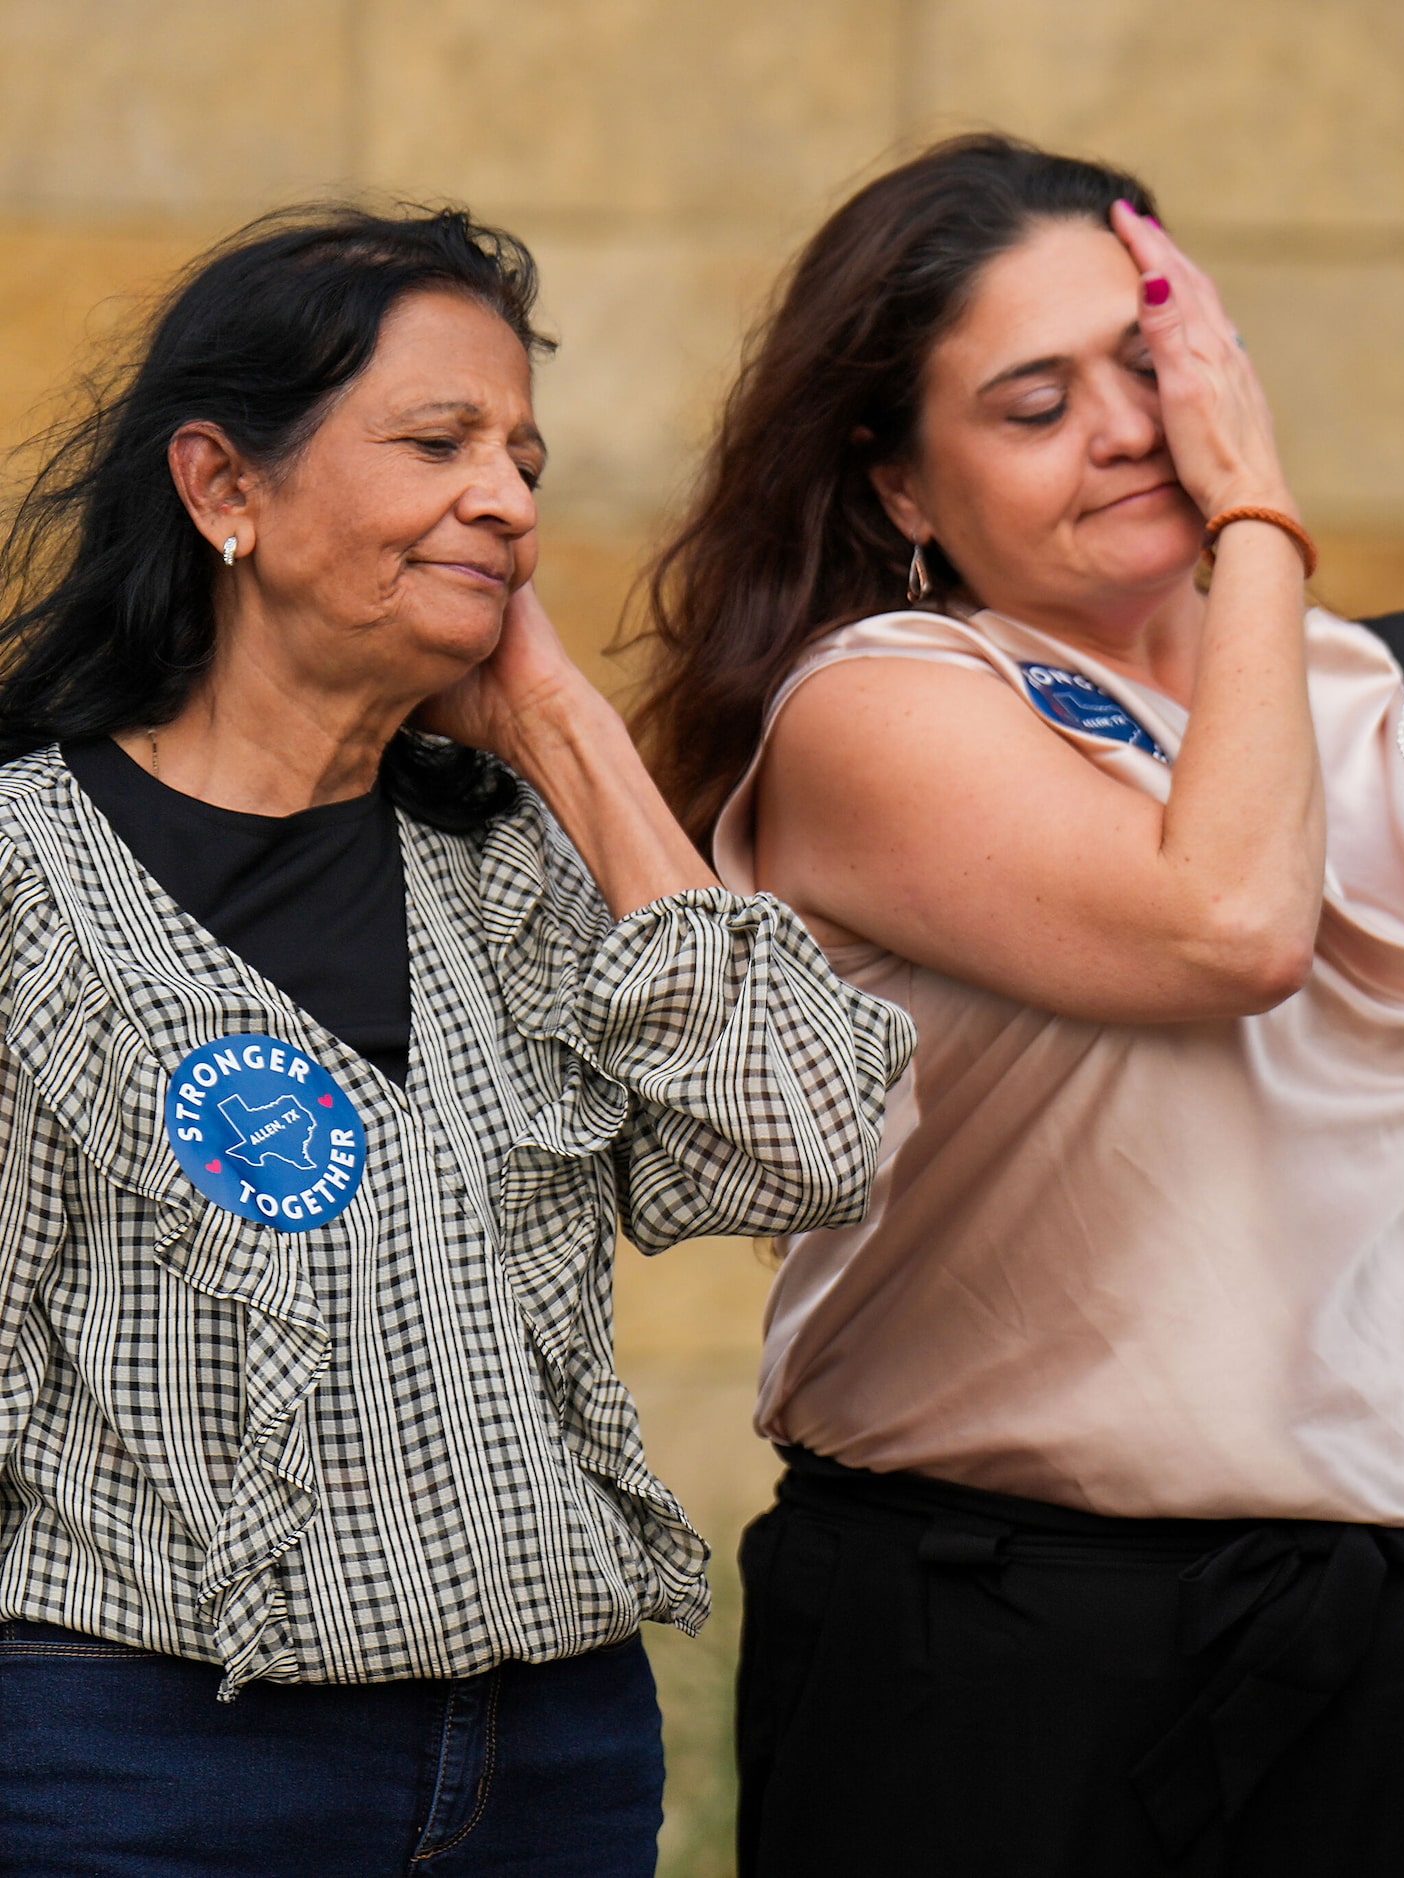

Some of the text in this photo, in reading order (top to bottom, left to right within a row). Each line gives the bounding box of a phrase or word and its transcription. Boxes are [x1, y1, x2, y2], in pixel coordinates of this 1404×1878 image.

[175, 1045, 310, 1142] STRONGER
[248, 1108, 301, 1146] ALLEN, TX
[239, 1128, 355, 1220] TOGETHER
